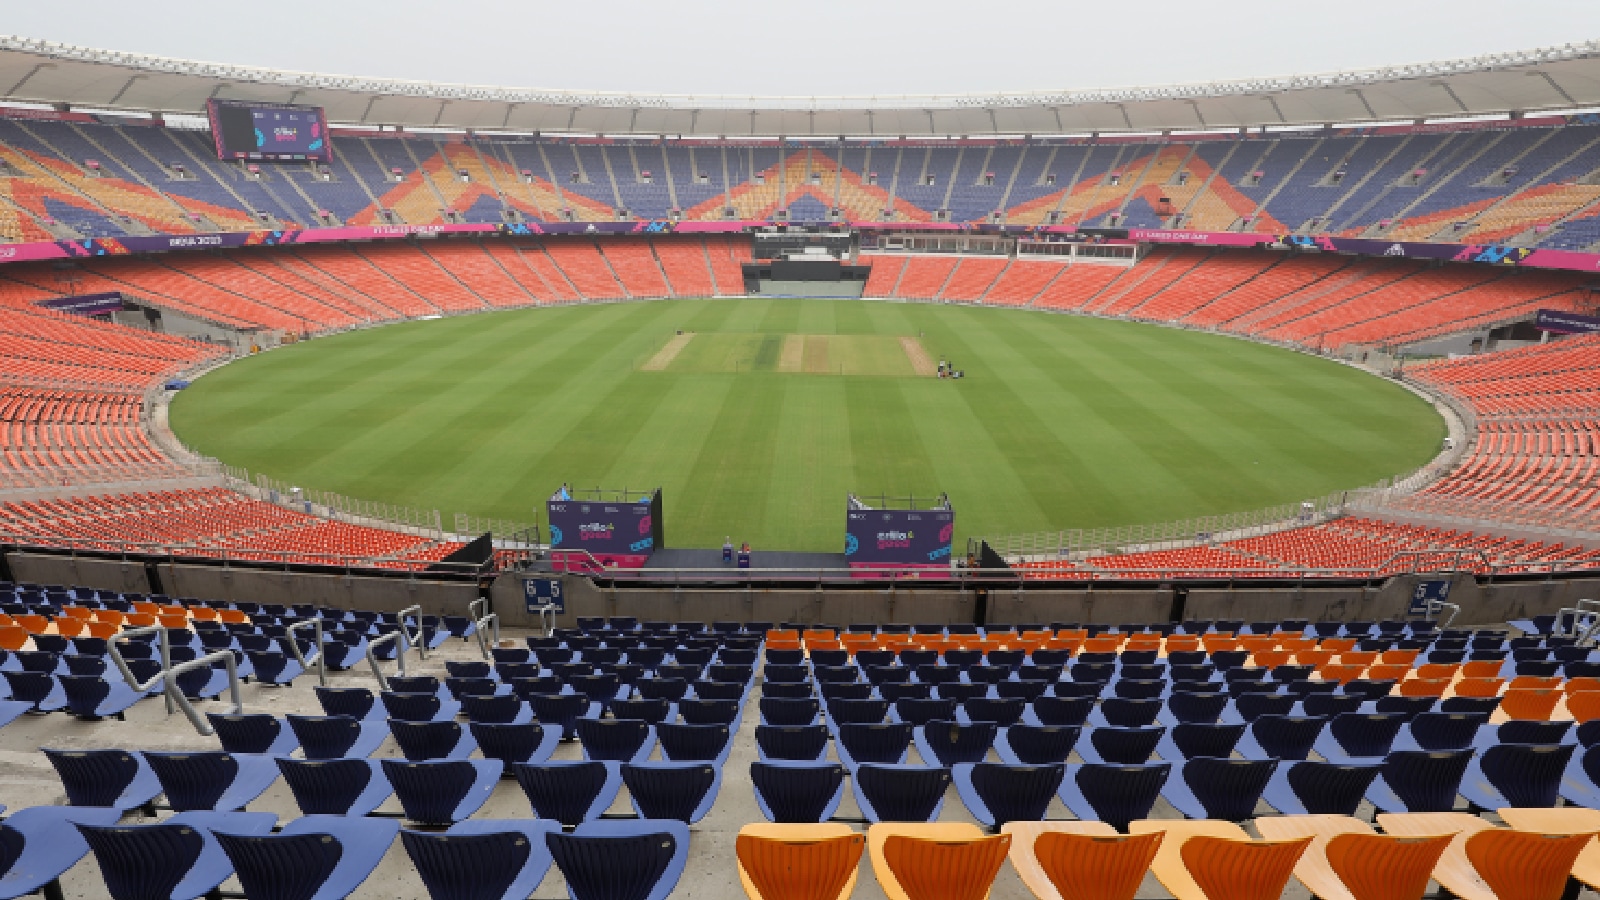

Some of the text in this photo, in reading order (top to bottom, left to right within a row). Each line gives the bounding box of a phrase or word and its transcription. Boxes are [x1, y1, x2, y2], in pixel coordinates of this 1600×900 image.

[580, 531, 611, 540] good
[527, 580, 560, 597] 6 5
[1416, 584, 1449, 599] 5 4
